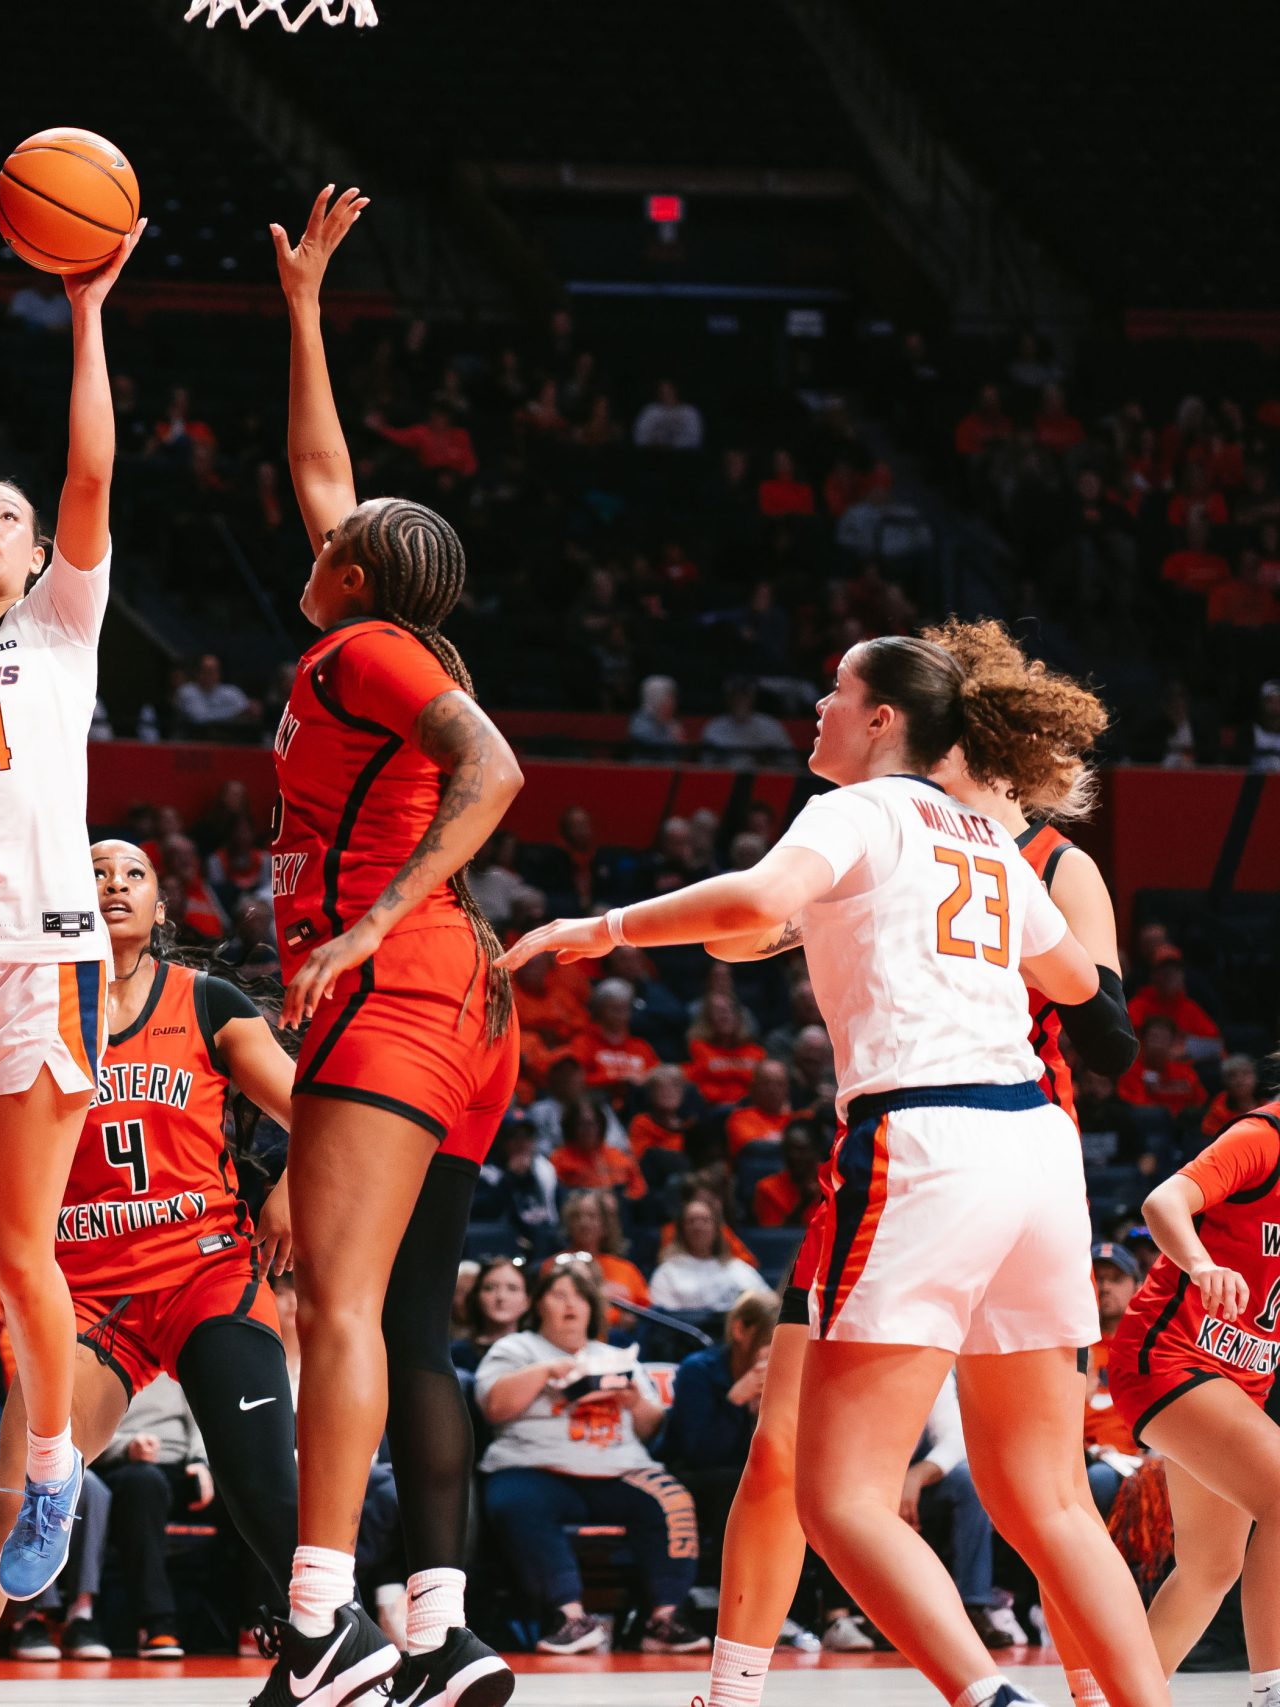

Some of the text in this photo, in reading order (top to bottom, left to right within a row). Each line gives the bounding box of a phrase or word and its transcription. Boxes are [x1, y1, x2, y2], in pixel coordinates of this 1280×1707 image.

[910, 797, 999, 848] WALLACE
[933, 845, 1009, 969] 23
[88, 1063, 193, 1110] STERN
[101, 1118, 150, 1195] 4
[55, 1191, 206, 1242] KENTUCKY
